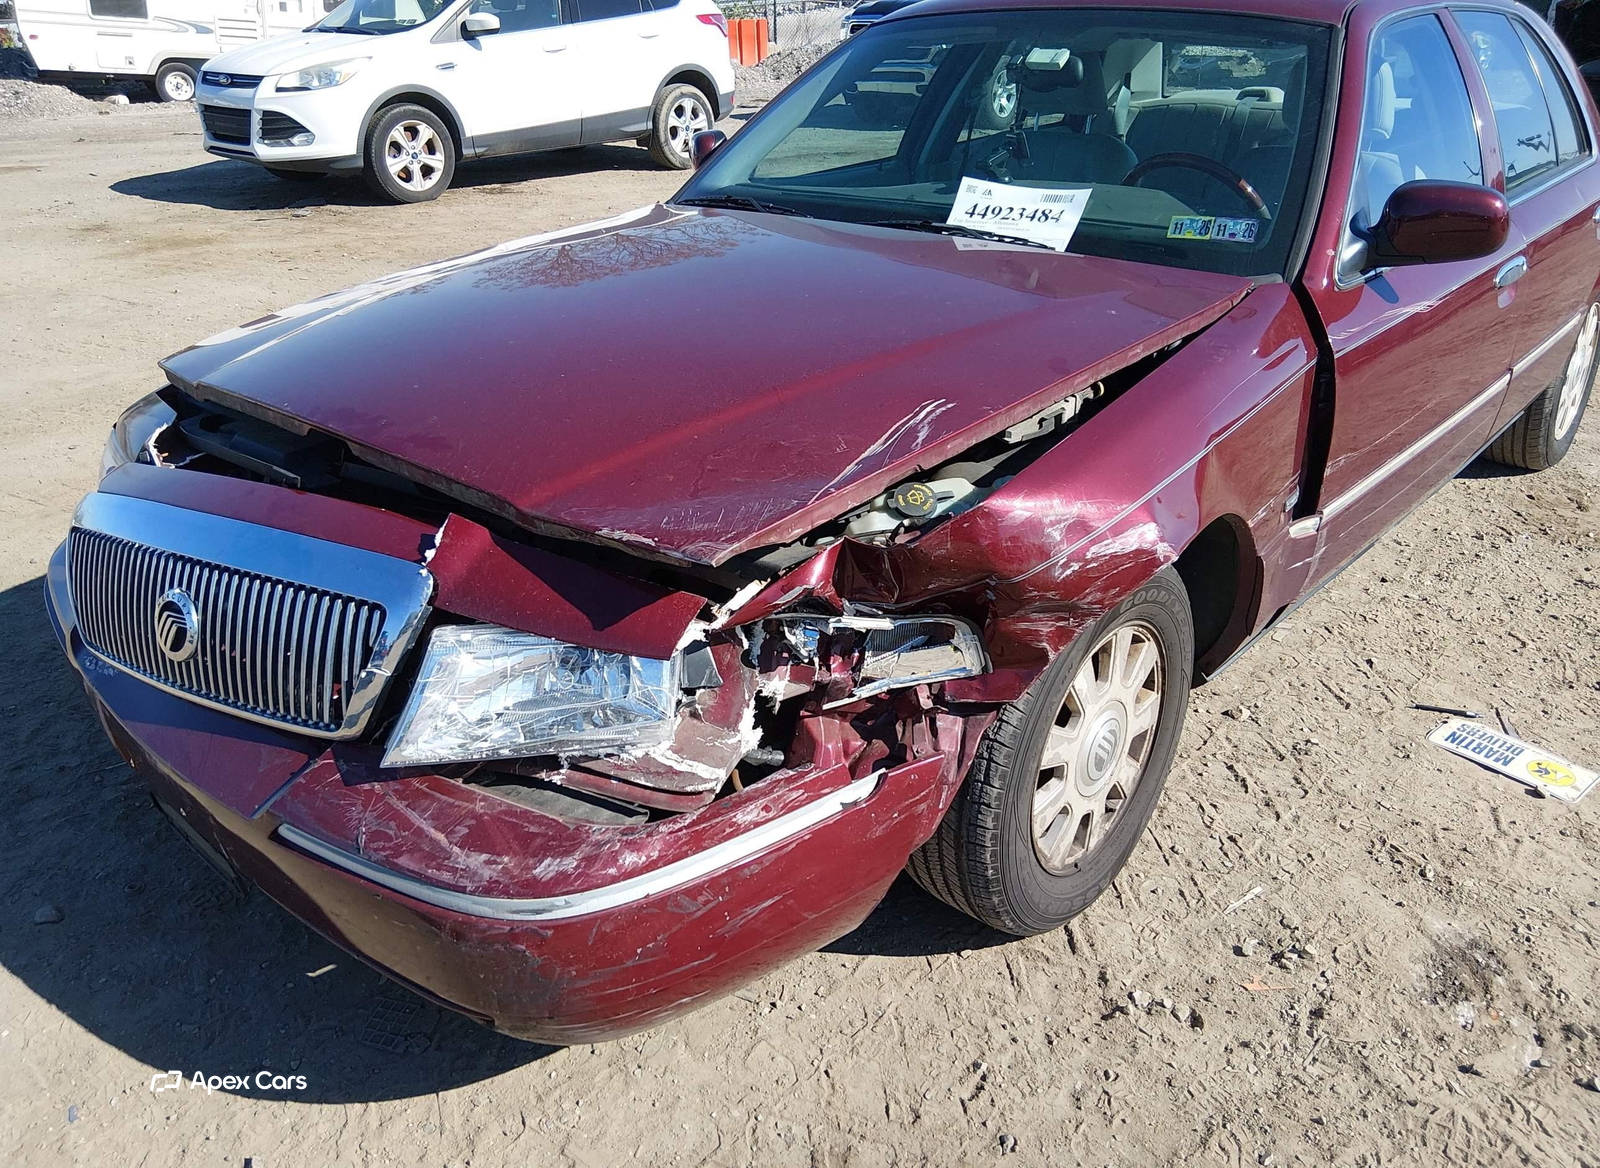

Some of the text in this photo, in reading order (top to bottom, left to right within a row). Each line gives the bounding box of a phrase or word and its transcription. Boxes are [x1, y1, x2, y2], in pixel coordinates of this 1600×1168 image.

[965, 203, 1065, 223] 44923484
[1173, 220, 1211, 235] 11 26
[1216, 222, 1256, 238] 11 26
[1444, 730, 1516, 767] MARTIN
[1456, 723, 1527, 757] DELIVERS
